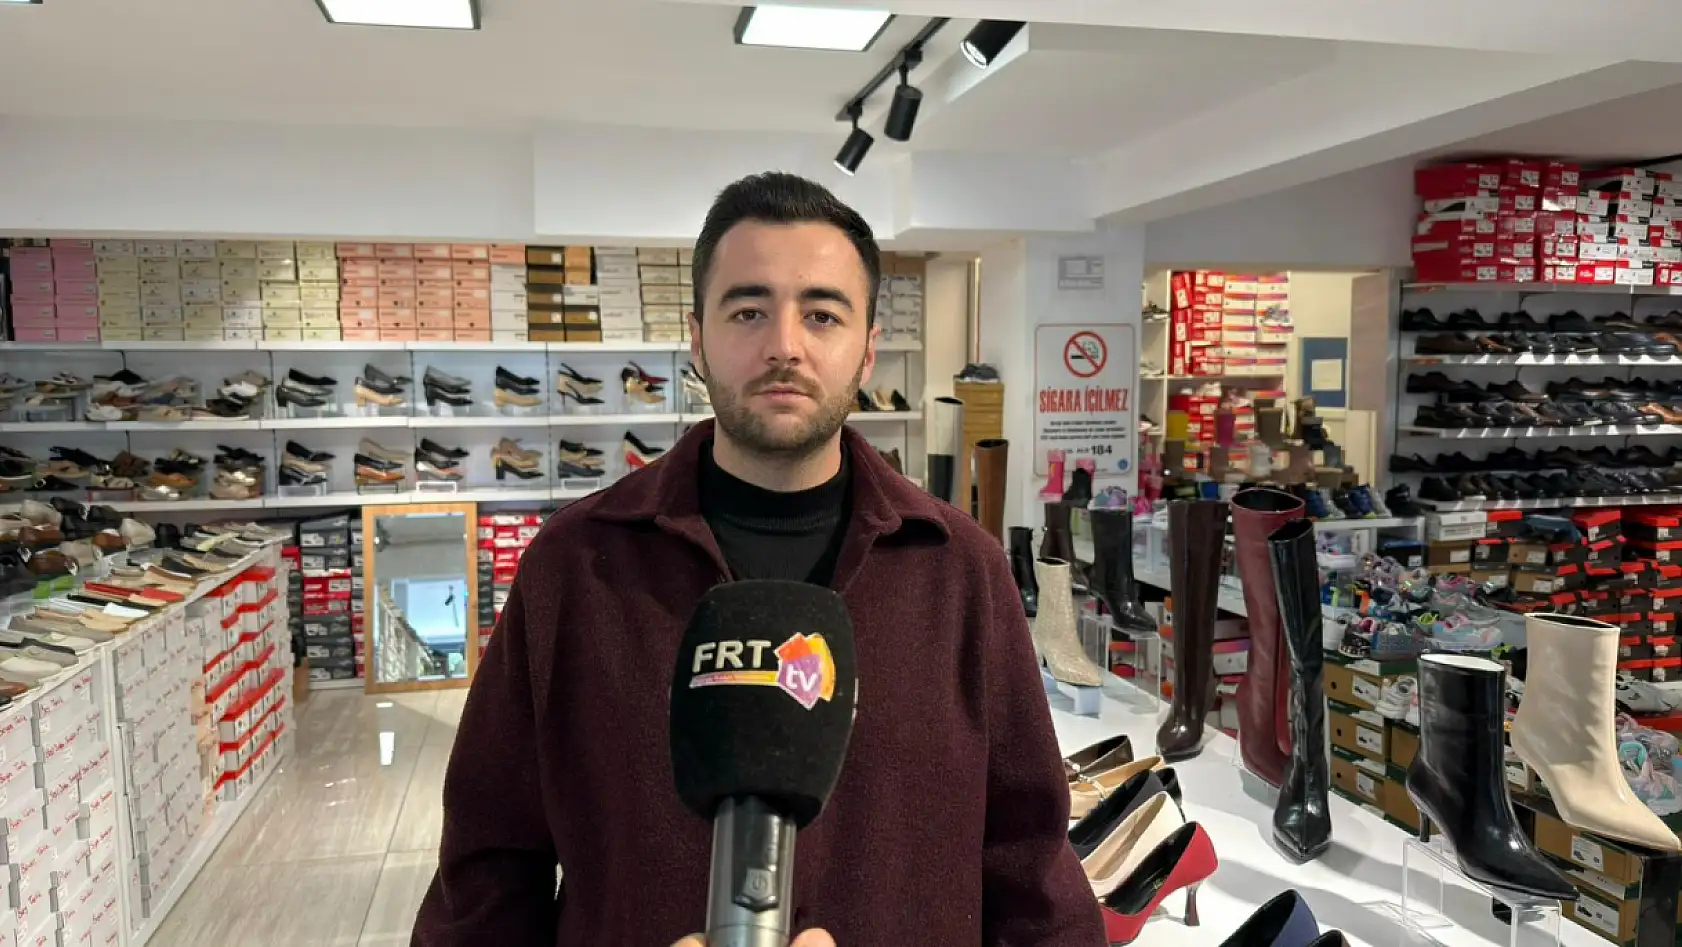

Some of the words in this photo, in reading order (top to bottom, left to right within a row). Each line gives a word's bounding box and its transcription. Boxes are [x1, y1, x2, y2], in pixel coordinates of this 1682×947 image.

[1039, 386, 1081, 413] SİGARA
[1084, 384, 1128, 415] İÇİLMEZ
[1091, 444, 1113, 455] 184
[693, 640, 771, 672] FRT
[787, 664, 818, 692] tv
